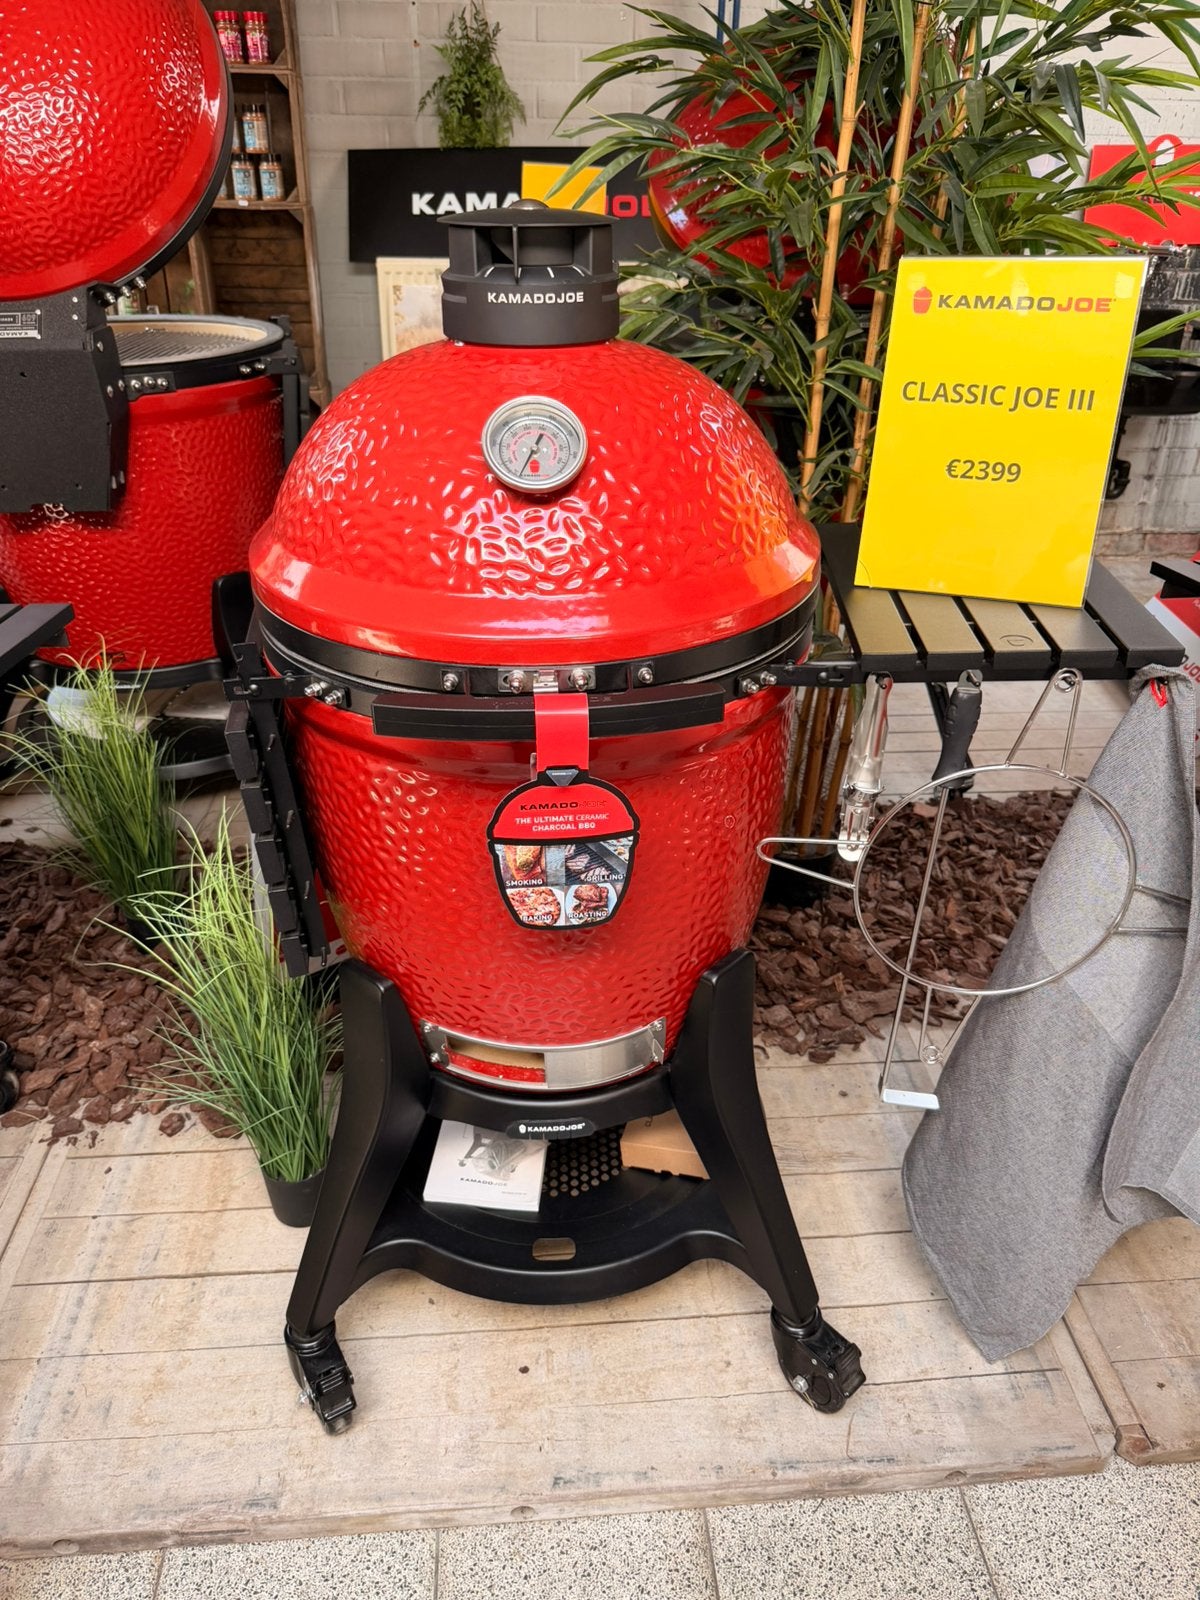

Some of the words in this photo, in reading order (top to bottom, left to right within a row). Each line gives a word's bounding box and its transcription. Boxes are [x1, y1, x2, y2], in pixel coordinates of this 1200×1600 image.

[487, 291, 584, 304] KAMADOJOE
[938, 294, 1113, 313] KAMADOJOE
[902, 381, 1006, 406] CLASSIC
[1008, 386, 1060, 412] JOE
[1067, 389, 1095, 411] III
[946, 458, 1022, 482] €2399
[515, 817, 531, 825] THE
[533, 814, 574, 824] ULTIMATE
[576, 813, 609, 821] CERAMIC
[532, 823, 576, 832] CHARCOAL
[568, 911, 608, 919] ROASTING
[527, 1123, 583, 1132] KAMADOJOE
